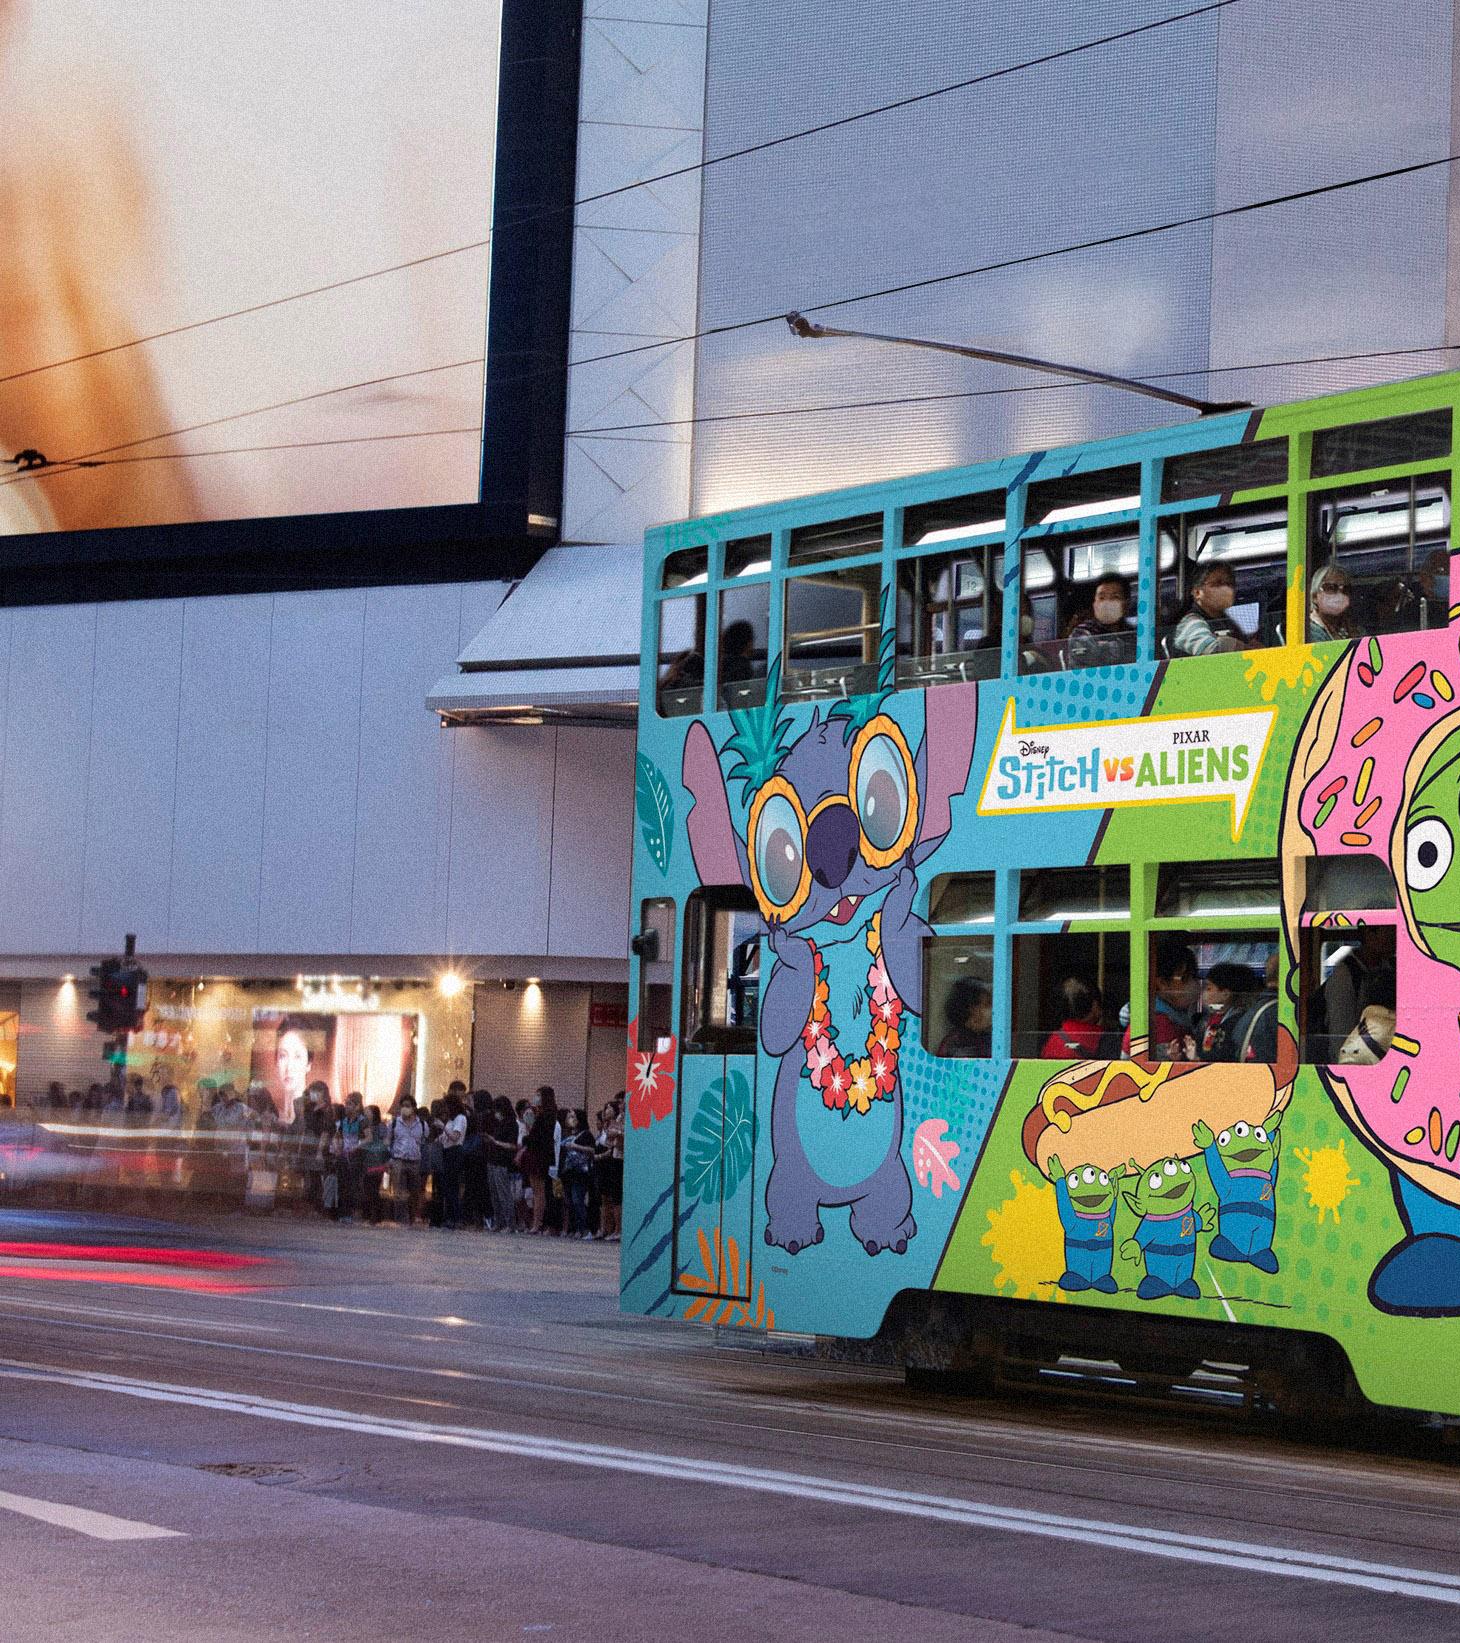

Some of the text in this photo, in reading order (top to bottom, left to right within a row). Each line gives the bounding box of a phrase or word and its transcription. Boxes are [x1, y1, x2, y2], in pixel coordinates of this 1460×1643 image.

[1172, 729, 1210, 744] PIXAR
[1018, 740, 1050, 759] Disney
[1135, 745, 1249, 788] ALIENS
